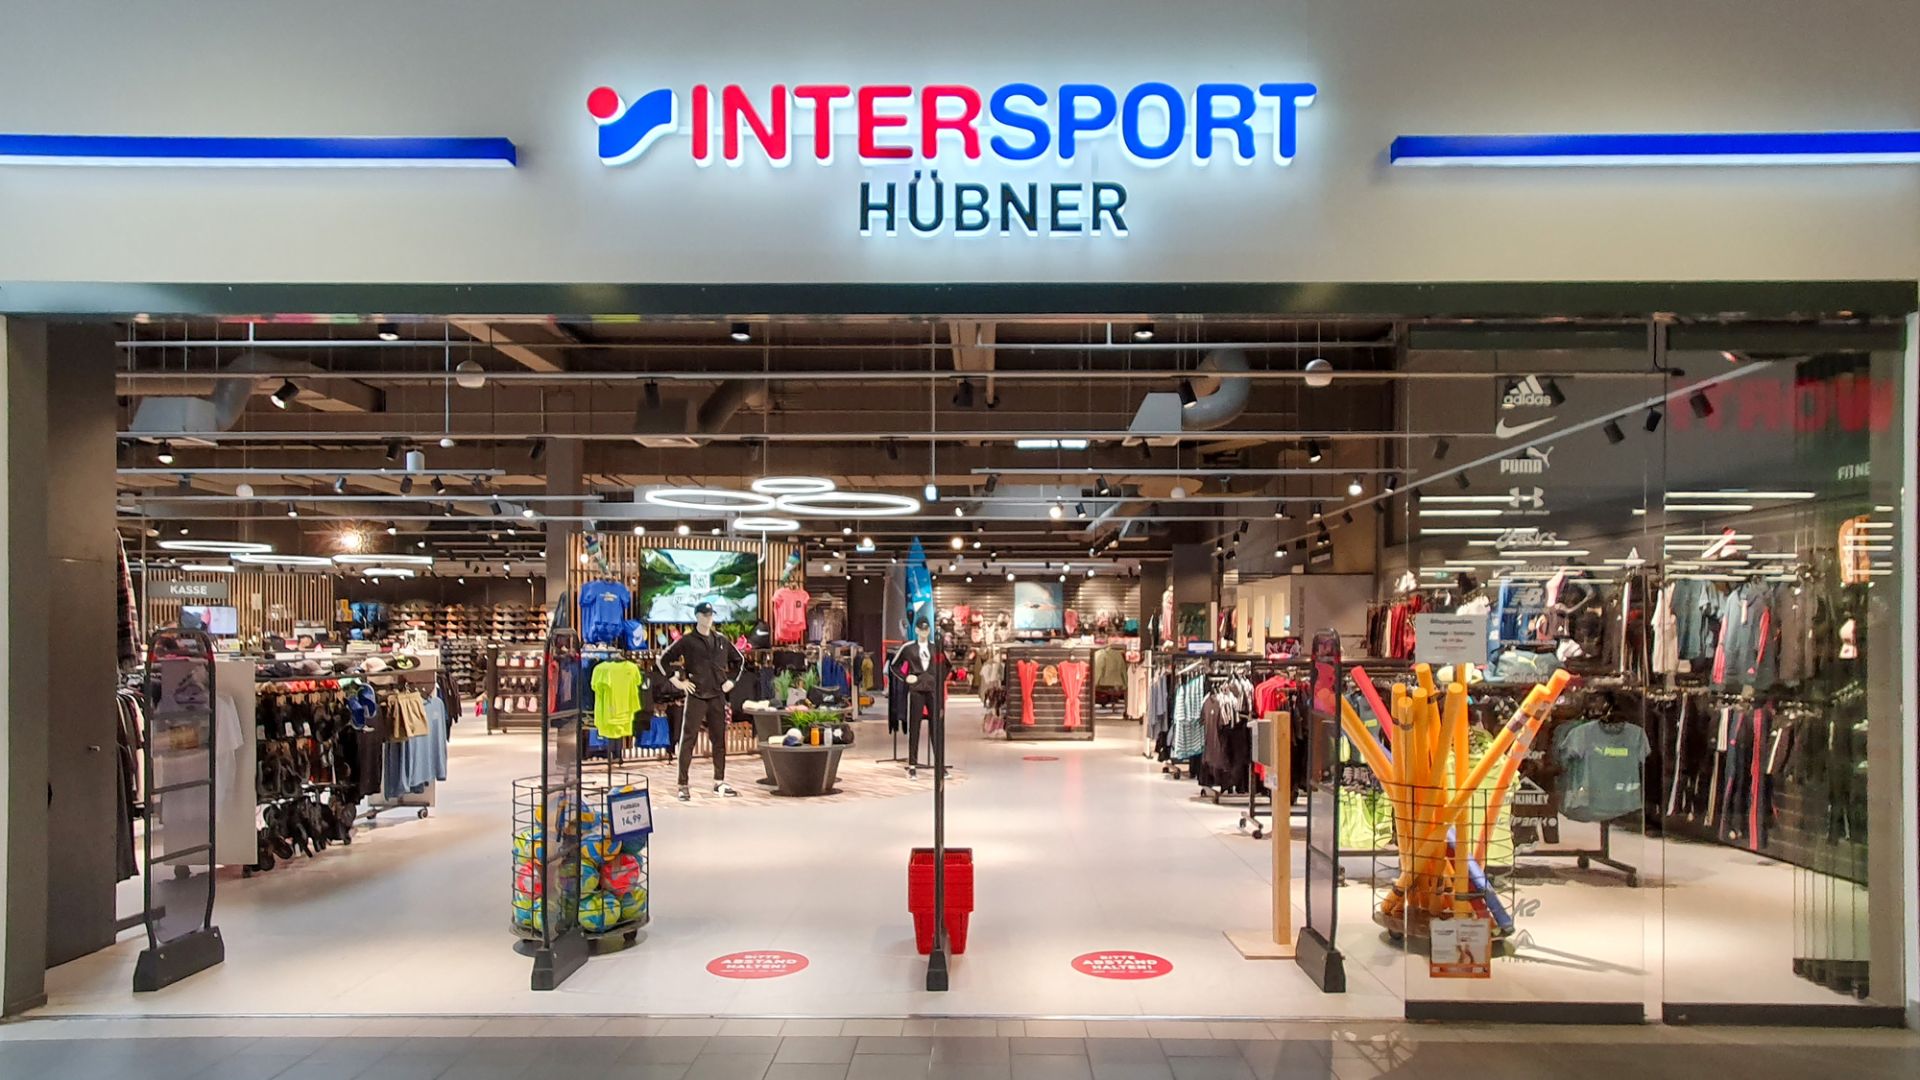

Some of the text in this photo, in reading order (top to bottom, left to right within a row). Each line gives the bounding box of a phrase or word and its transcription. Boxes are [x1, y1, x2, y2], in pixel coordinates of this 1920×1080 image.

[690, 82, 1318, 162] INTERSPORT
[859, 170, 1128, 234] HÜBNER
[1503, 393, 1551, 406] adidas
[170, 585, 208, 594] KASSE
